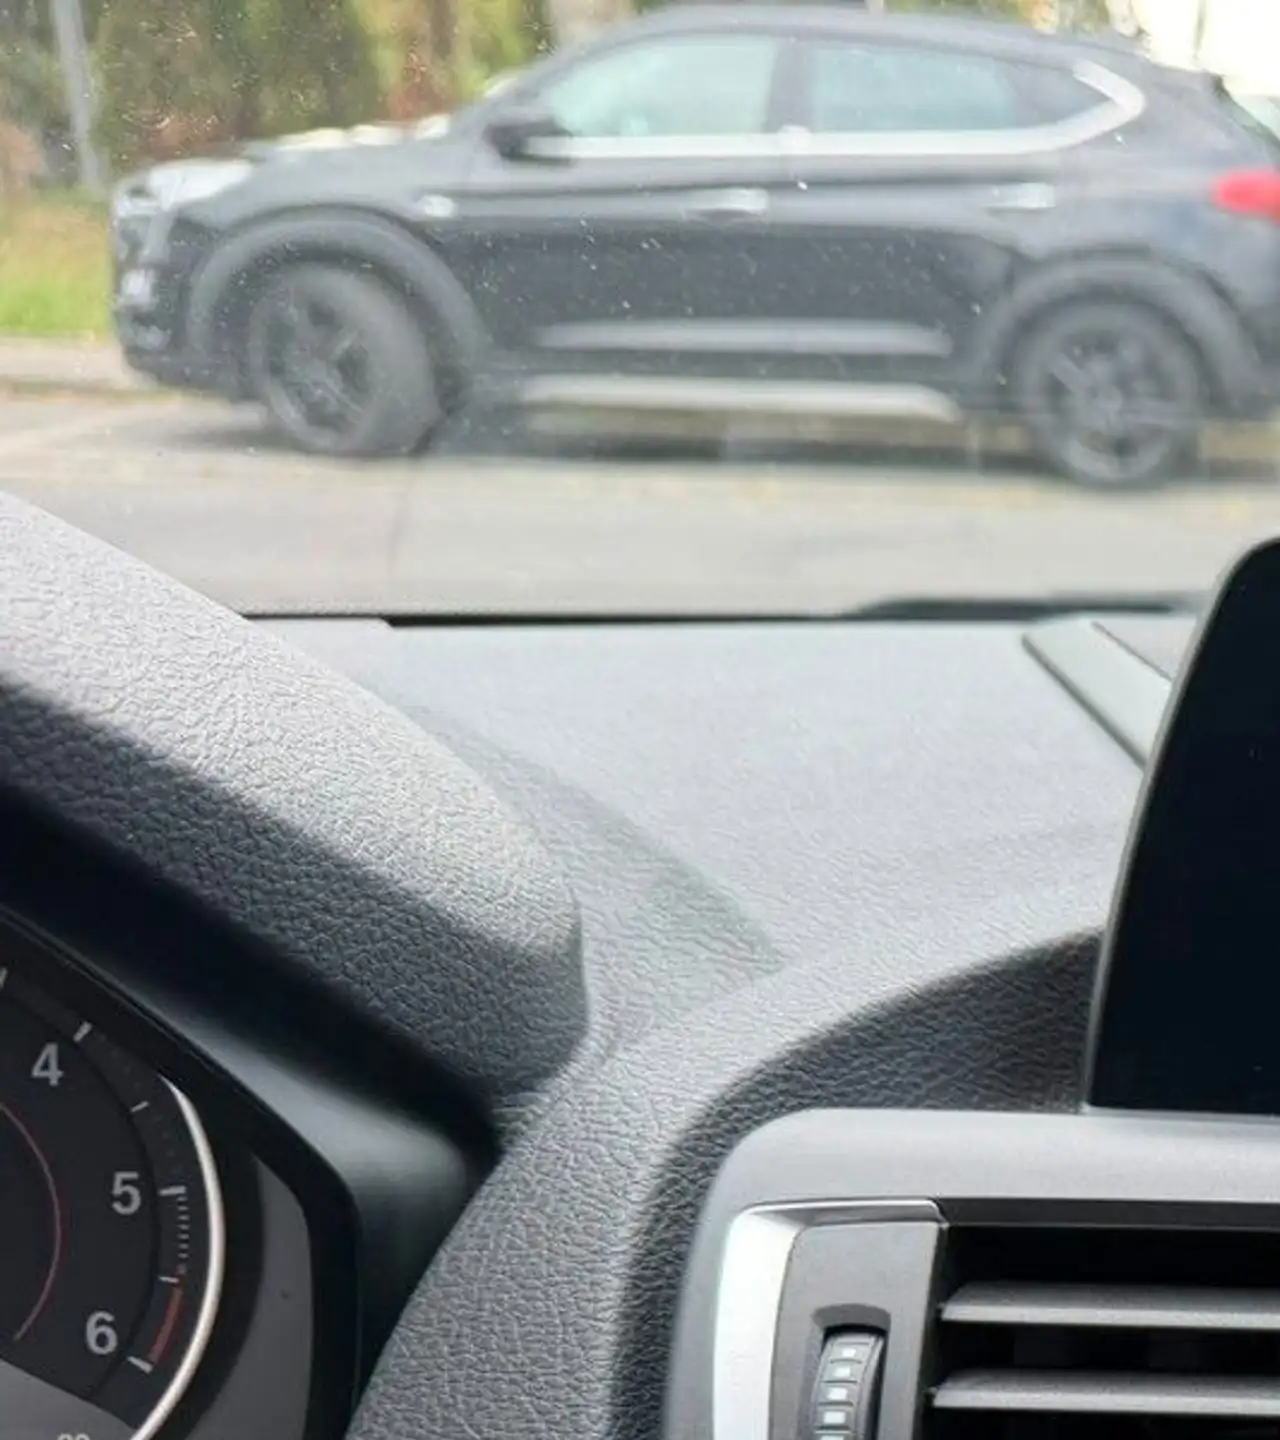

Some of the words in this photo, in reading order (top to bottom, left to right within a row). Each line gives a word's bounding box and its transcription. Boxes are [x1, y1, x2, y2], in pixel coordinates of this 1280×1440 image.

[31, 1042, 65, 1087] 4
[111, 1171, 142, 1216] 5
[85, 1311, 119, 1355] 6
